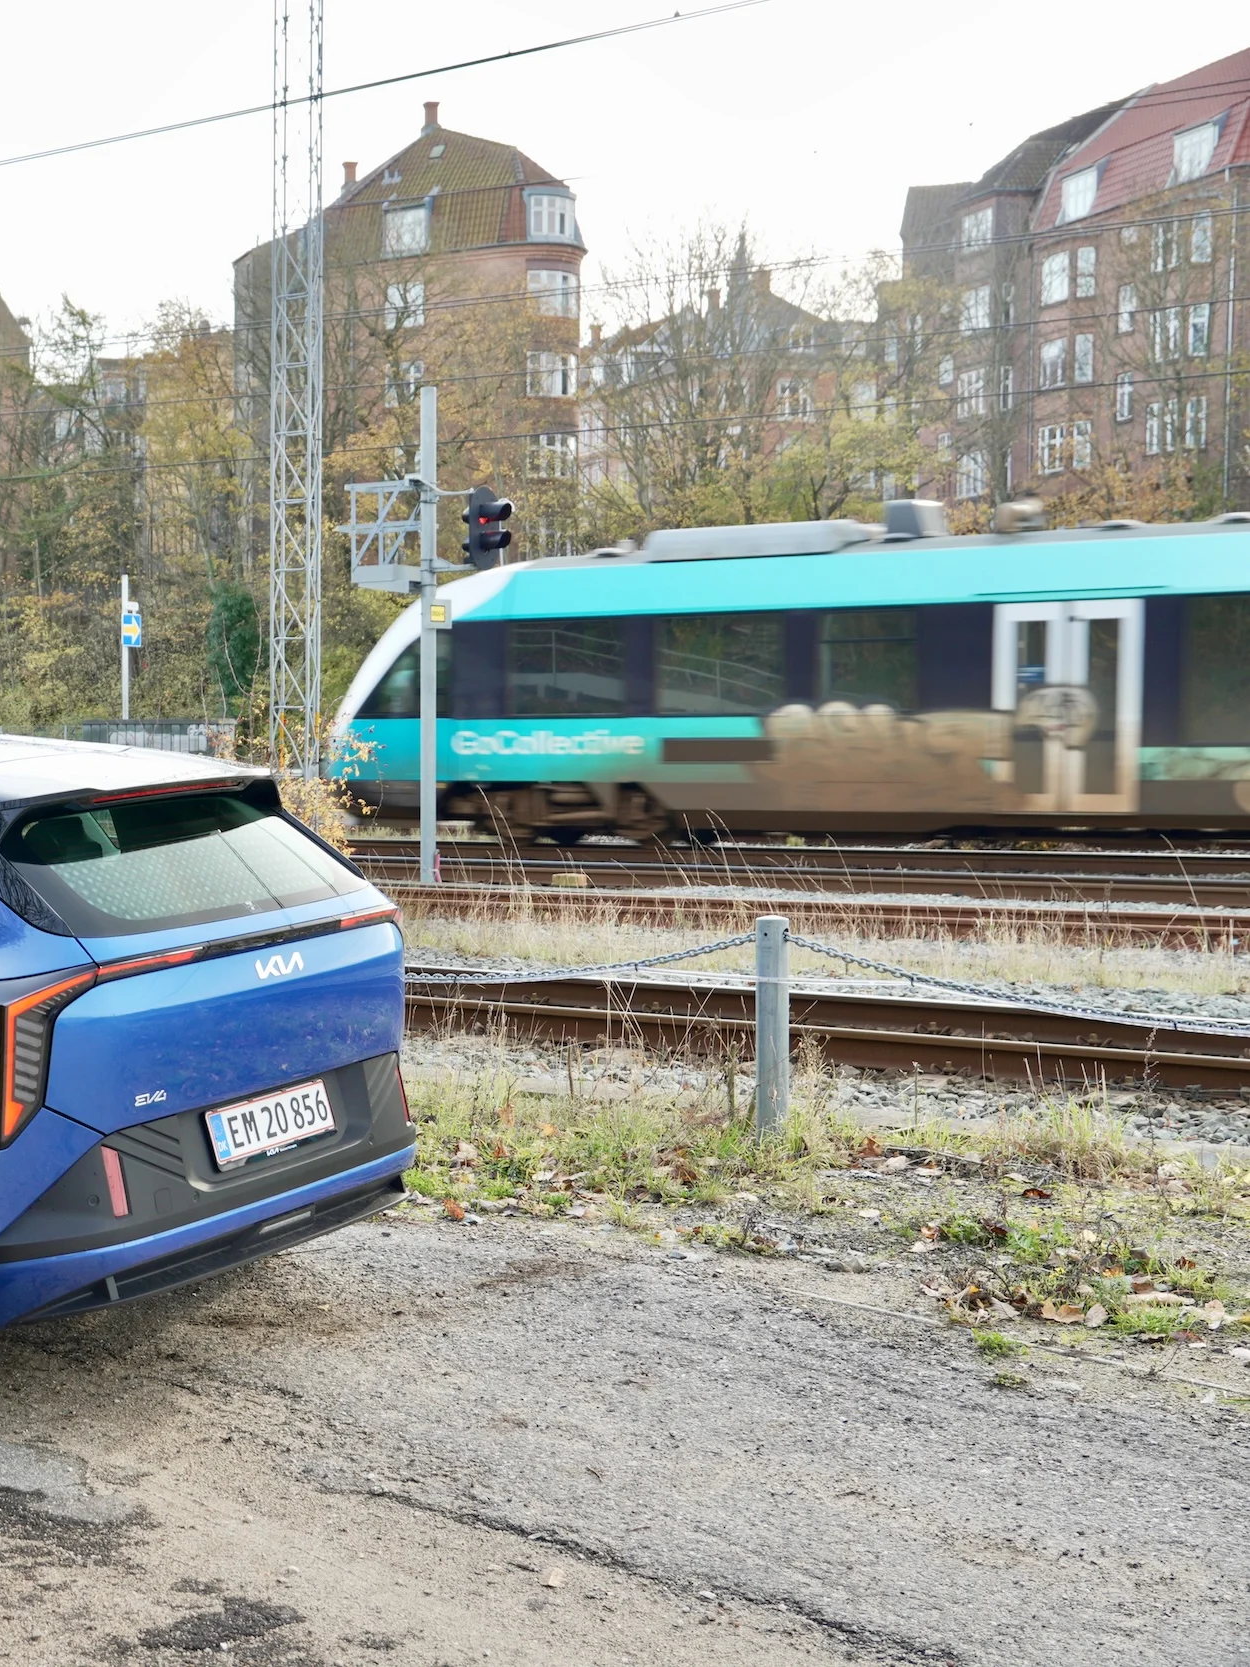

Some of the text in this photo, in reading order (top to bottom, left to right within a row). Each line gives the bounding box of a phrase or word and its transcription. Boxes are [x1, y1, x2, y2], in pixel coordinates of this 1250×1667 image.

[451, 729, 646, 755] GoCollective
[254, 951, 305, 980] KIA
[134, 1089, 167, 1107] EV4
[227, 1089, 328, 1149] EM 20 856
[217, 1141, 229, 1152] DK
